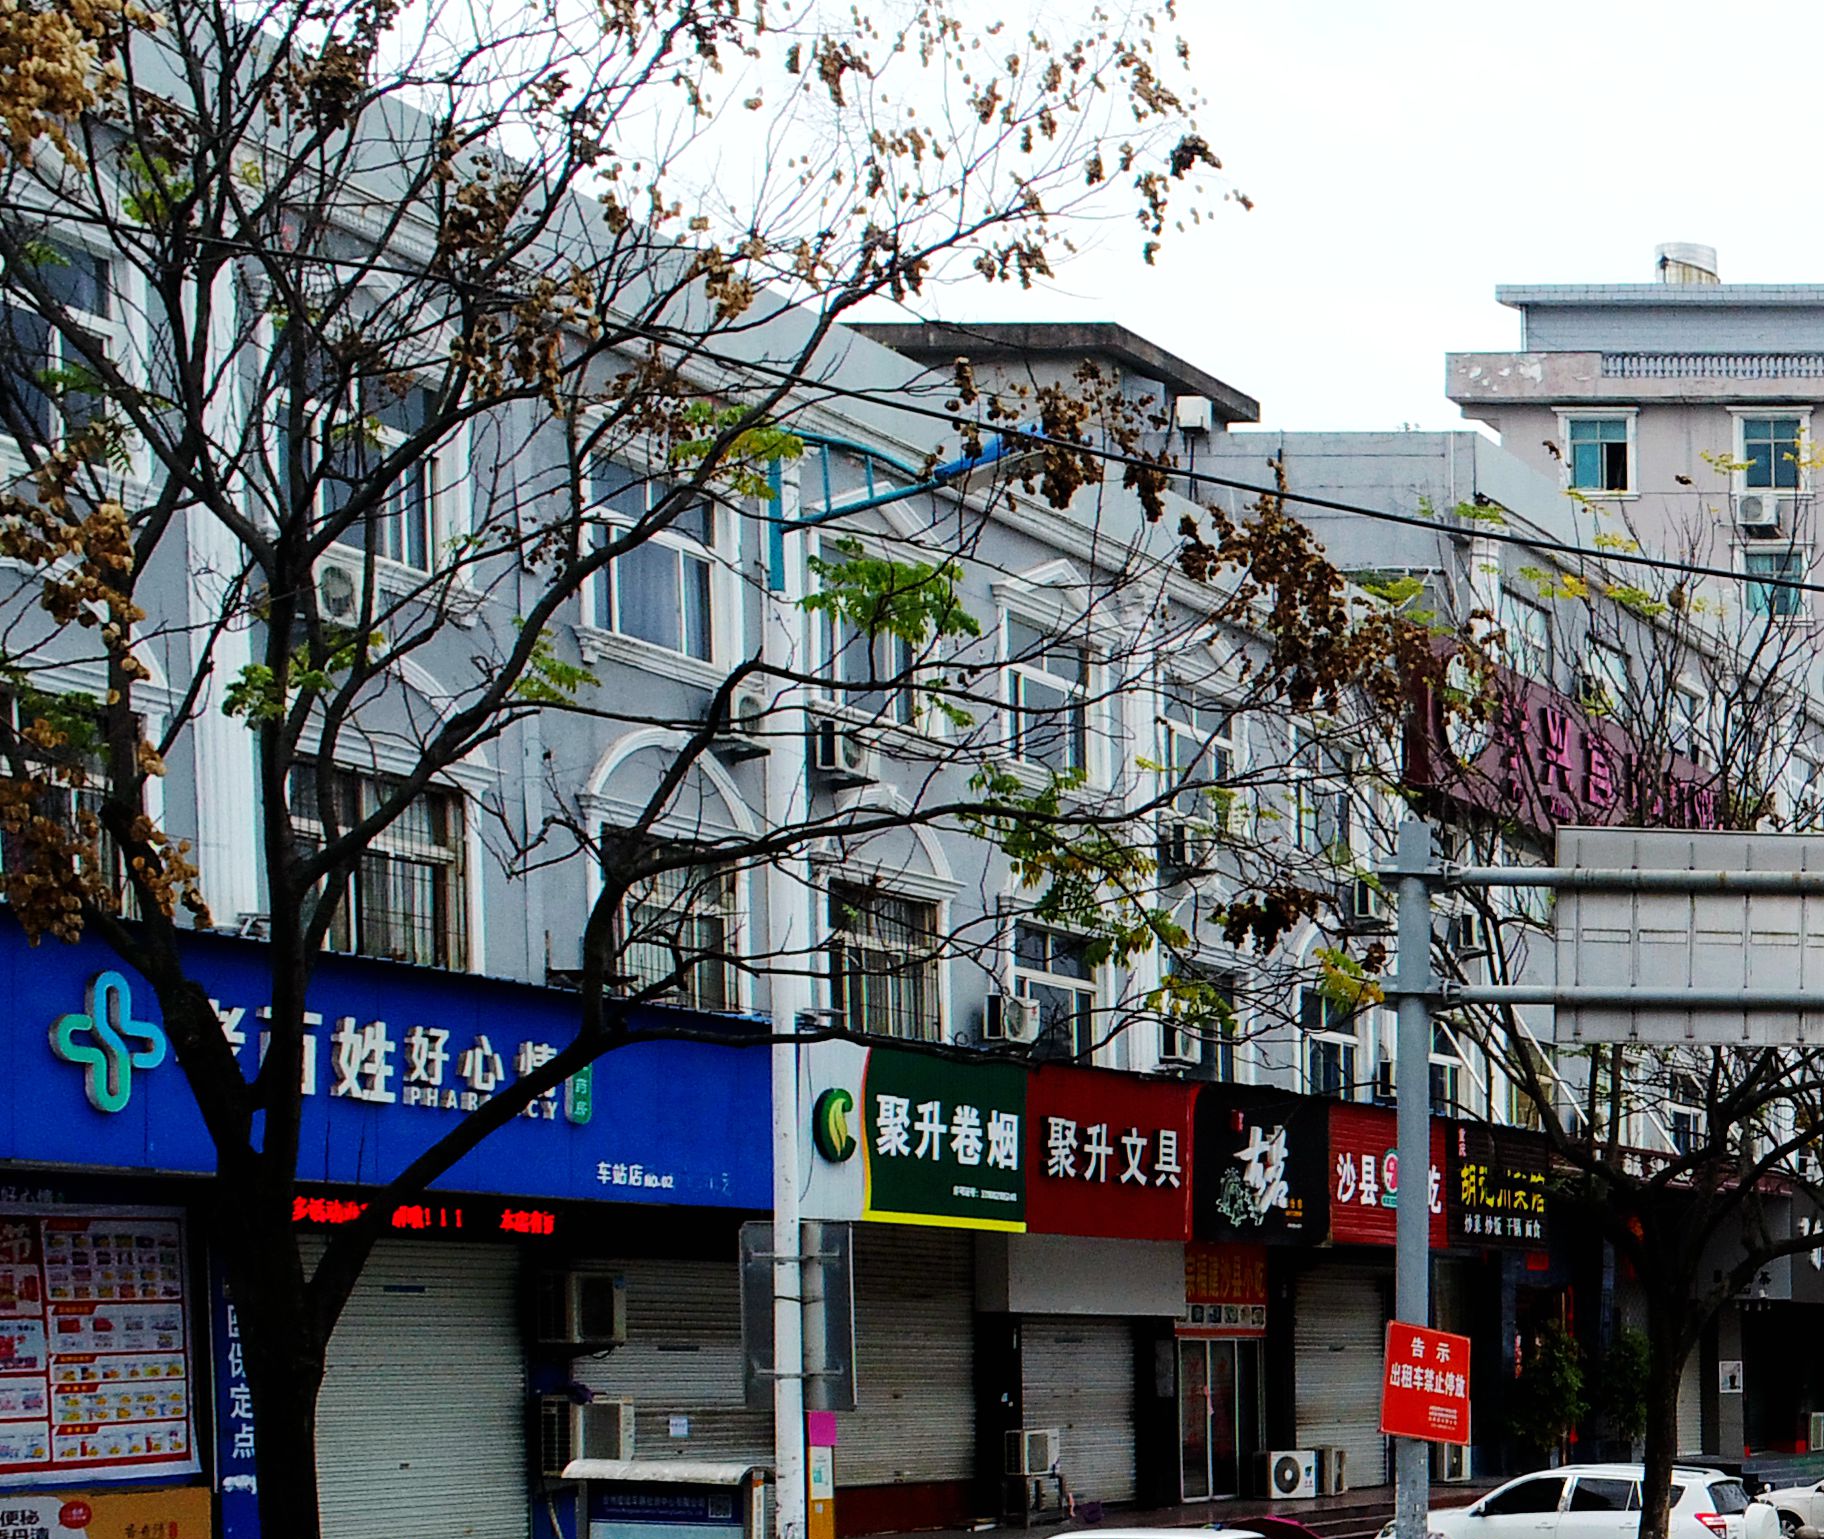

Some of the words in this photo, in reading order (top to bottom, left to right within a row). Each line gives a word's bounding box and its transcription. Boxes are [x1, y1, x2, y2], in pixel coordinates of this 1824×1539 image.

[403, 1086, 558, 1121] PHARCY
[875, 1093, 1019, 1171] 聚升卷烟
[1047, 1116, 1182, 1189] 聚升文具
[596, 1160, 643, 1186] 车站店
[1389, 1362, 1466, 1399] 出租车禁止停放
